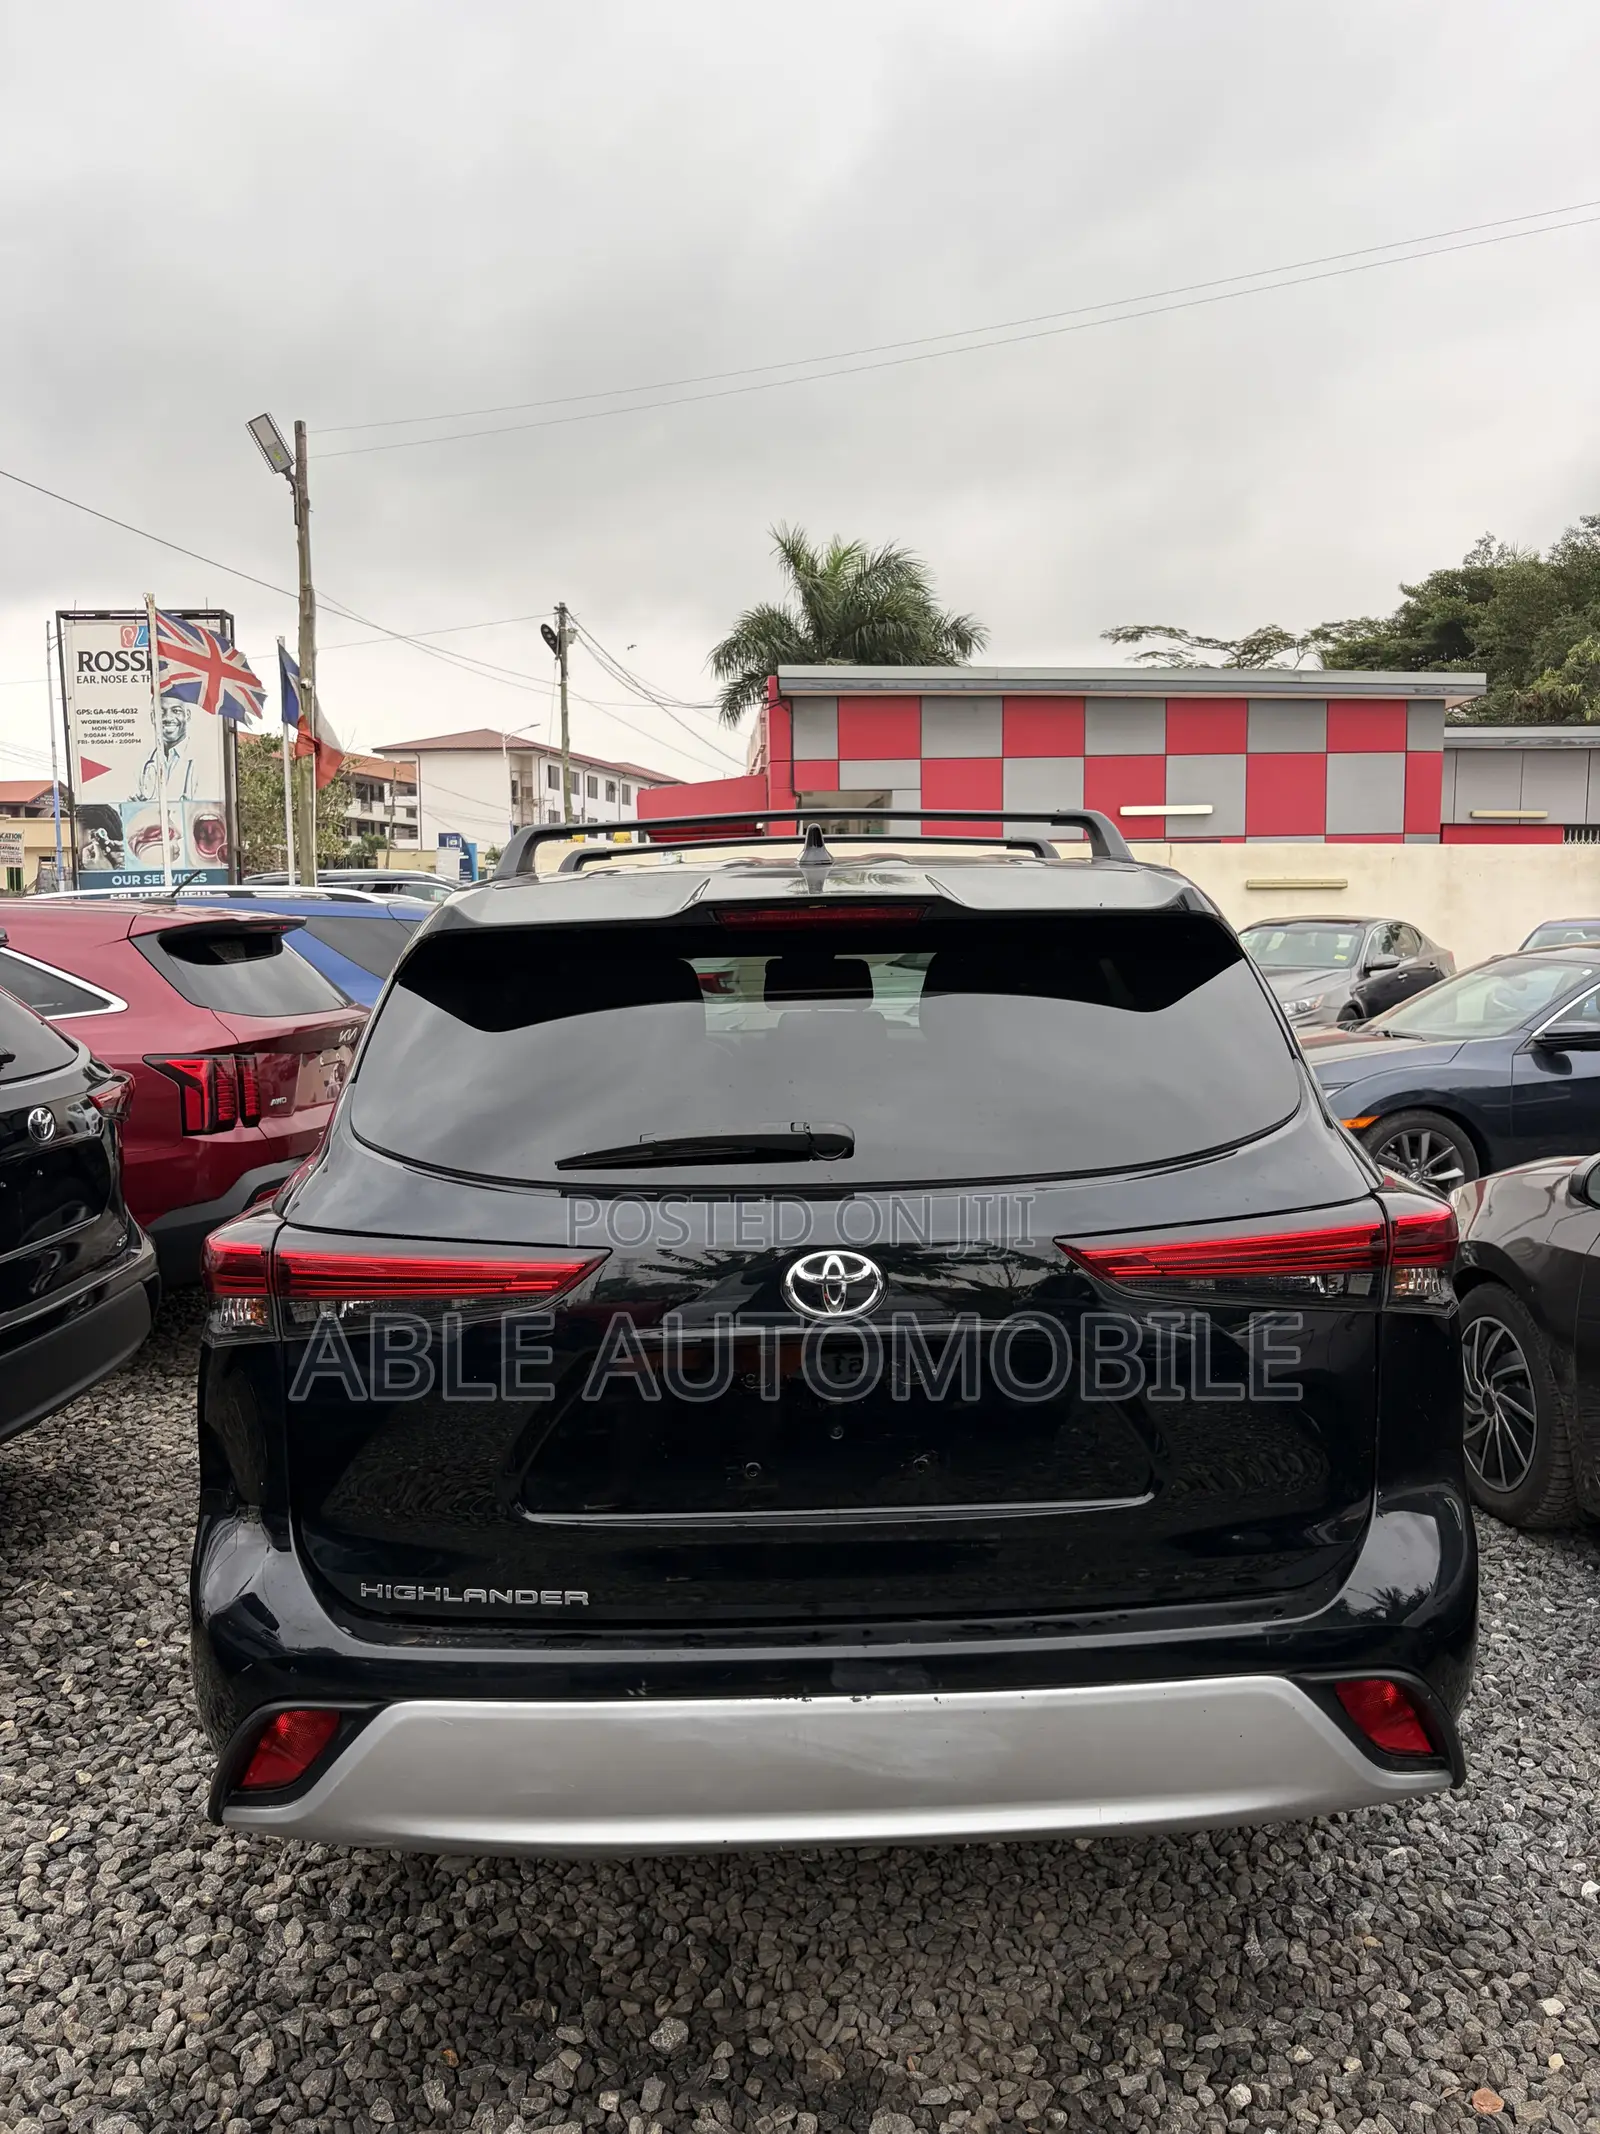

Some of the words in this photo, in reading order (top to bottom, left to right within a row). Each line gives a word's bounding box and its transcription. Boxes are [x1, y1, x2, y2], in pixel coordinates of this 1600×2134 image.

[101, 674, 128, 684] NOSE
[130, 674, 139, 683] &
[76, 708, 93, 716] GPS:
[111, 875, 141, 886] OUR
[360, 1582, 590, 1606] HIGHLANDER
